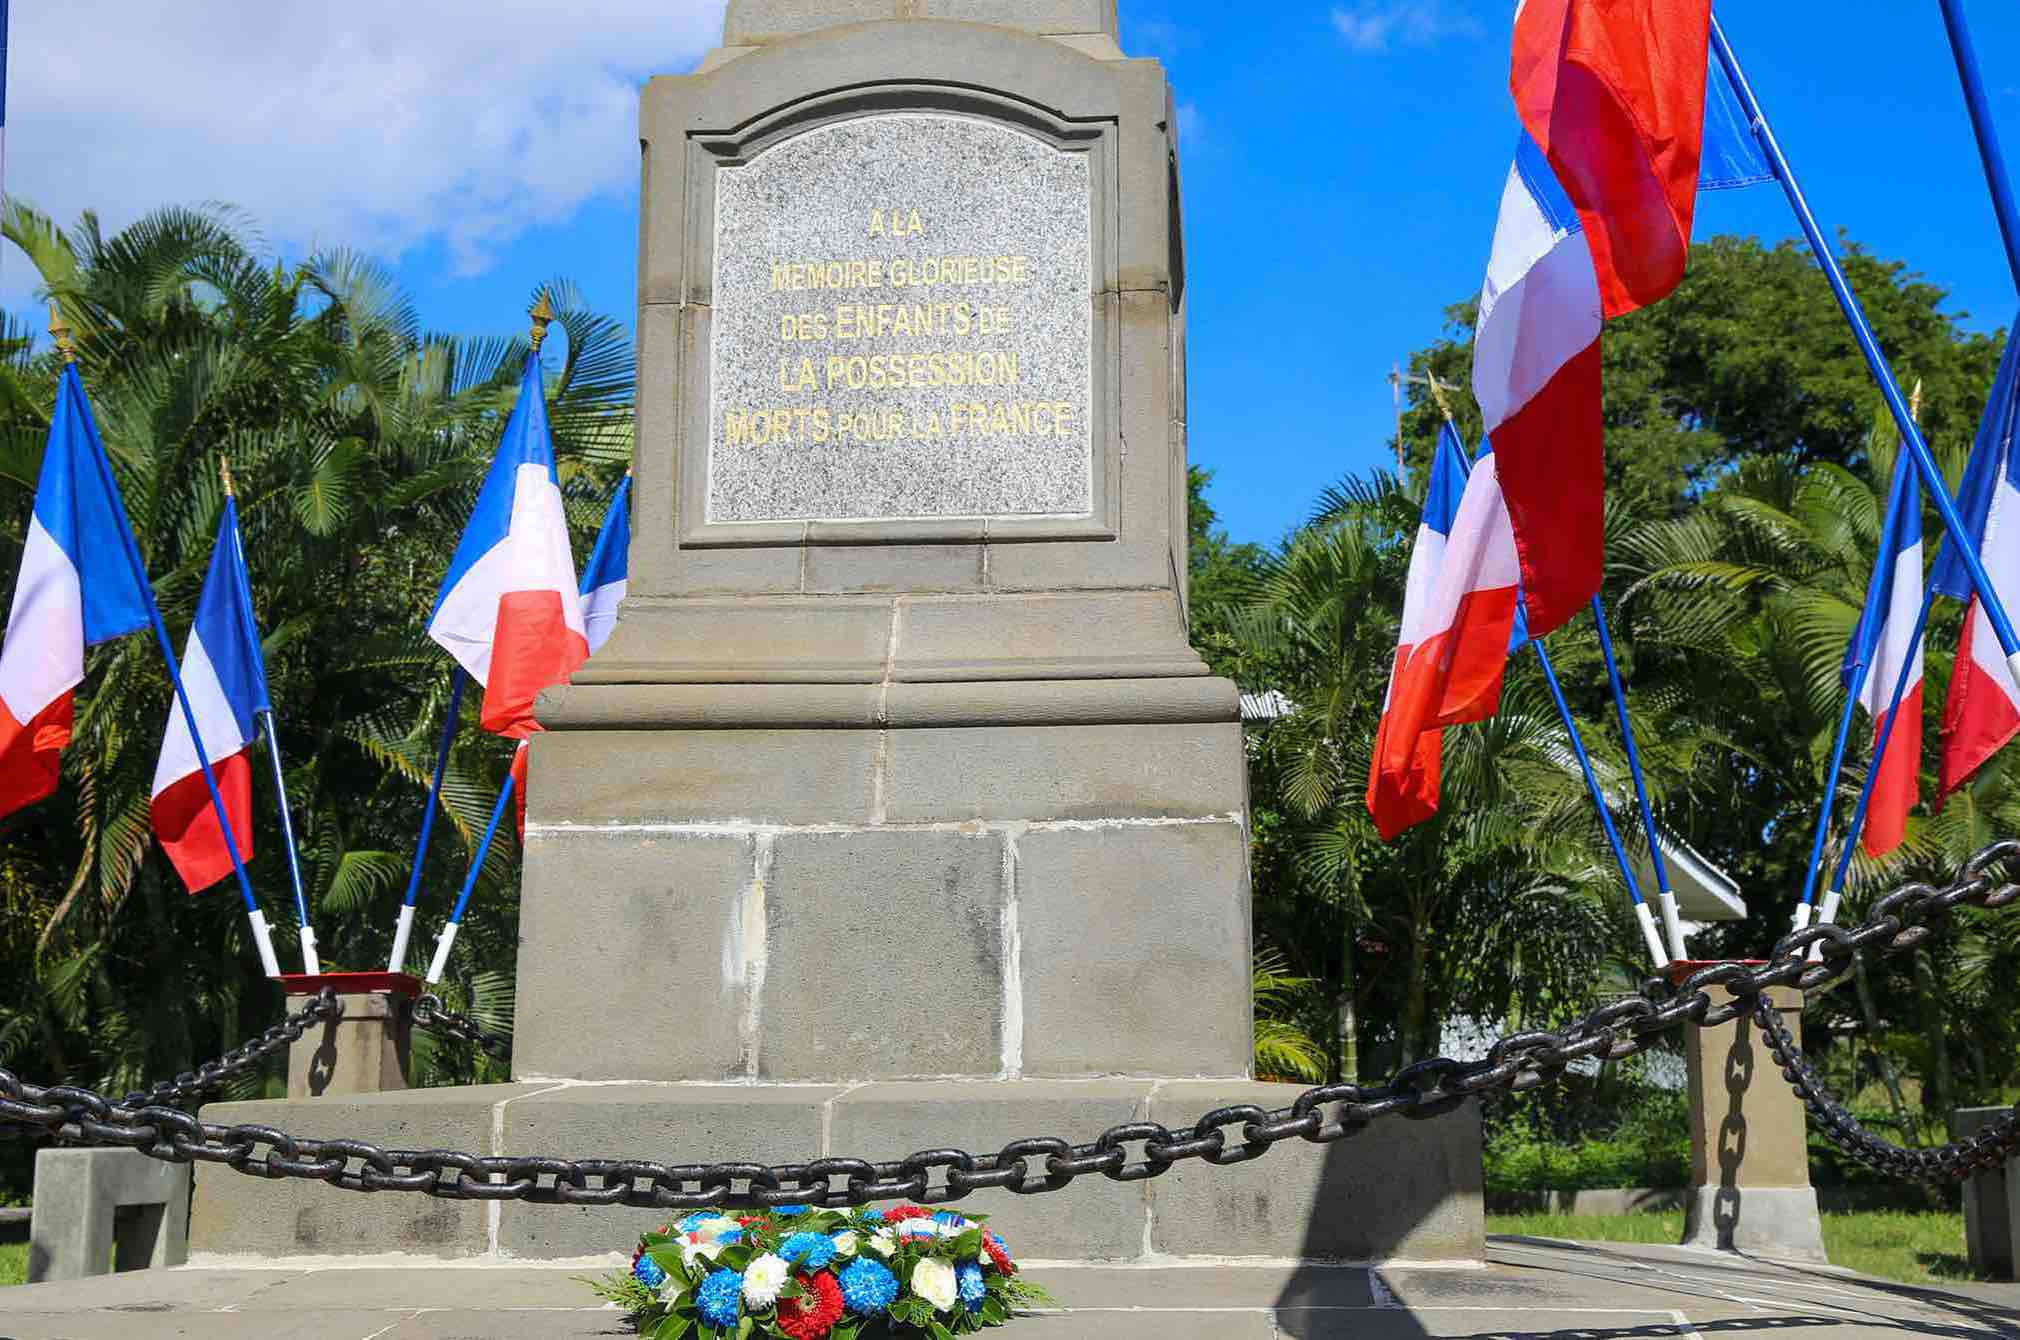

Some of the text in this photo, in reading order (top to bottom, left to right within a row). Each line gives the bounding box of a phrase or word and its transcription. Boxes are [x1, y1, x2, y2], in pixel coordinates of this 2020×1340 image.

[869, 207, 925, 237] A LA
[771, 256, 1027, 289] MEMOIRE GLORIEUSE
[781, 303, 1010, 340] DES ENFANTS DE
[780, 351, 1019, 391] LA POSSESSION
[725, 400, 1073, 445] MORTS POUR LA FRANCE
